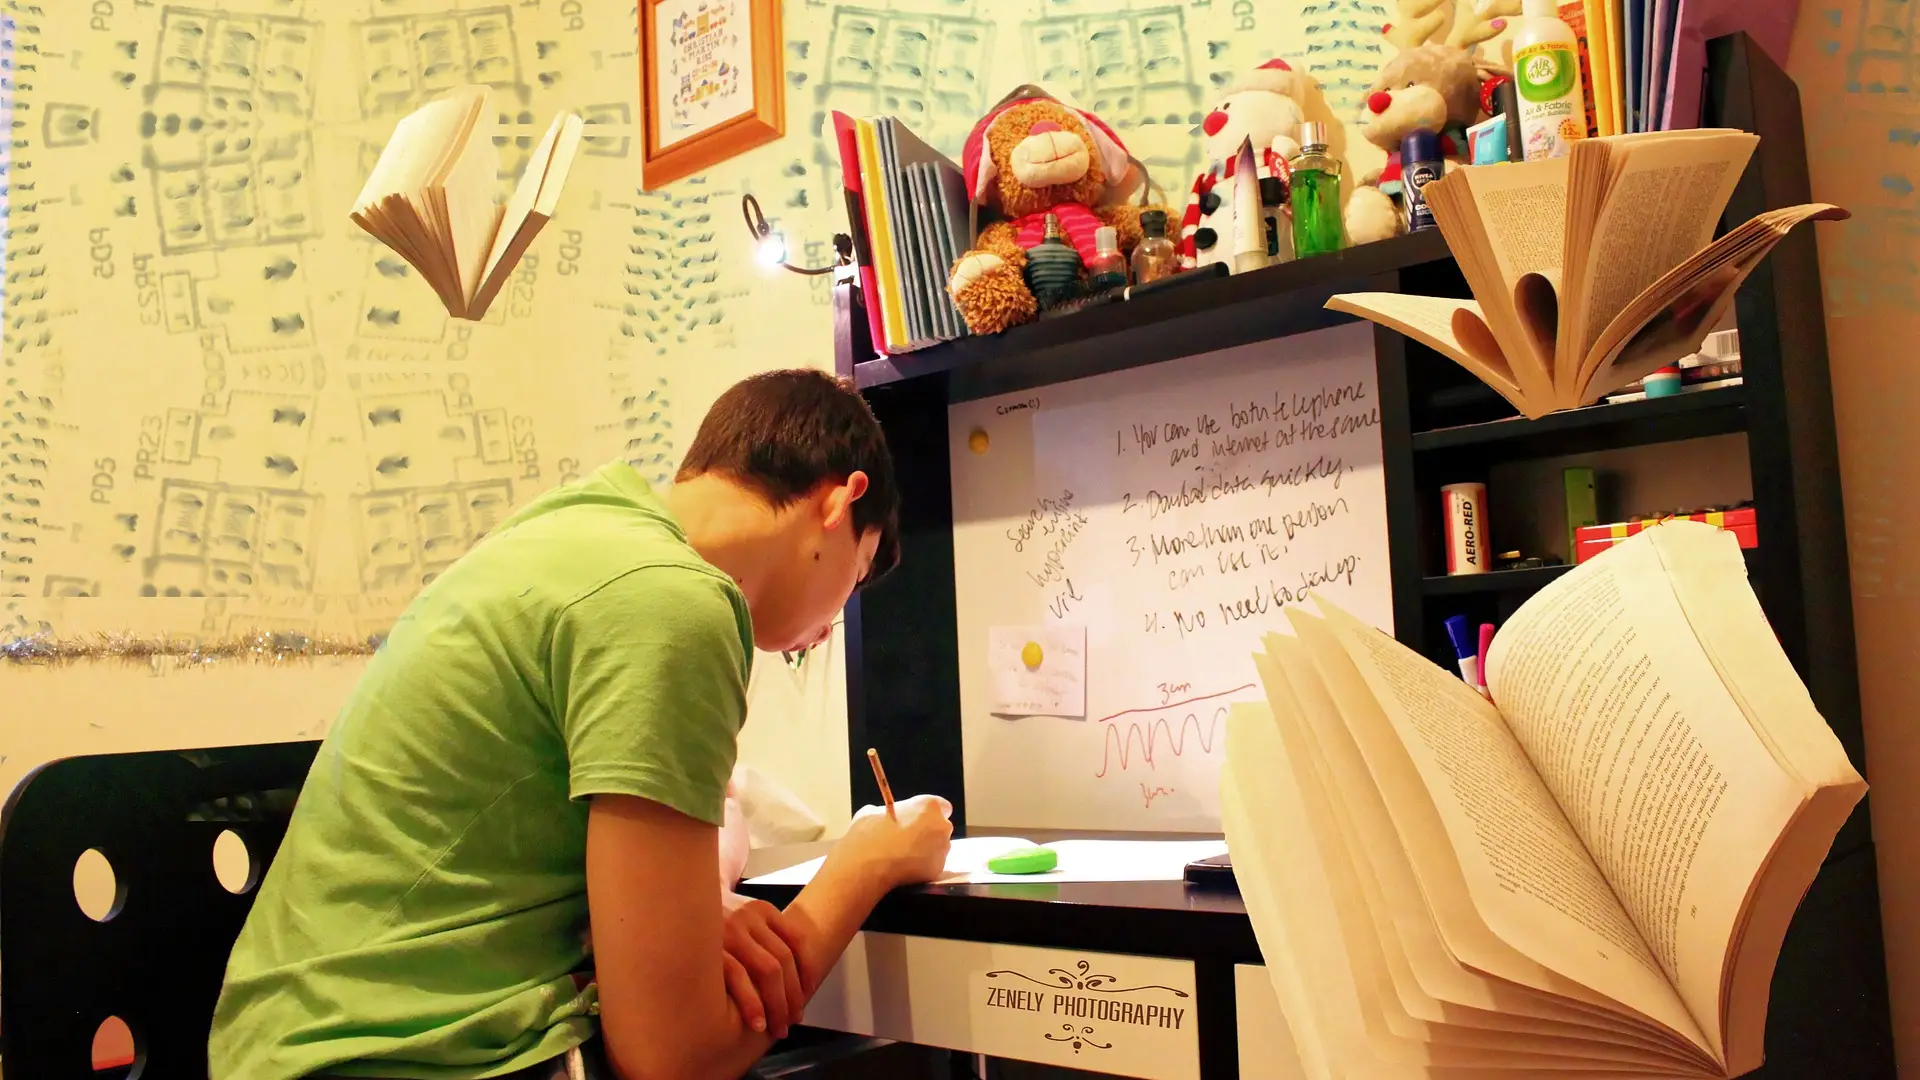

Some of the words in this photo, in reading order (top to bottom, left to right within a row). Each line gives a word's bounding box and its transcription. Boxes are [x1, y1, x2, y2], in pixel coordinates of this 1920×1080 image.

[1527, 66, 1554, 80] WICK
[1529, 57, 1550, 72] AIR
[1536, 104, 1543, 113] &
[1545, 101, 1573, 110] Fabric
[1164, 423, 1190, 443] can
[1196, 414, 1221, 436] use
[1230, 401, 1270, 429] both
[1273, 381, 1366, 423] telephone
[133, 415, 163, 481] PR23
[1170, 438, 1199, 467] and
[1212, 430, 1270, 458] internet
[1275, 423, 1298, 448] at
[90, 456, 117, 505] PD5
[1249, 516, 1279, 540] one
[1282, 497, 1349, 541] person
[1463, 500, 1477, 565] AERO-RED
[1219, 586, 1268, 626] need
